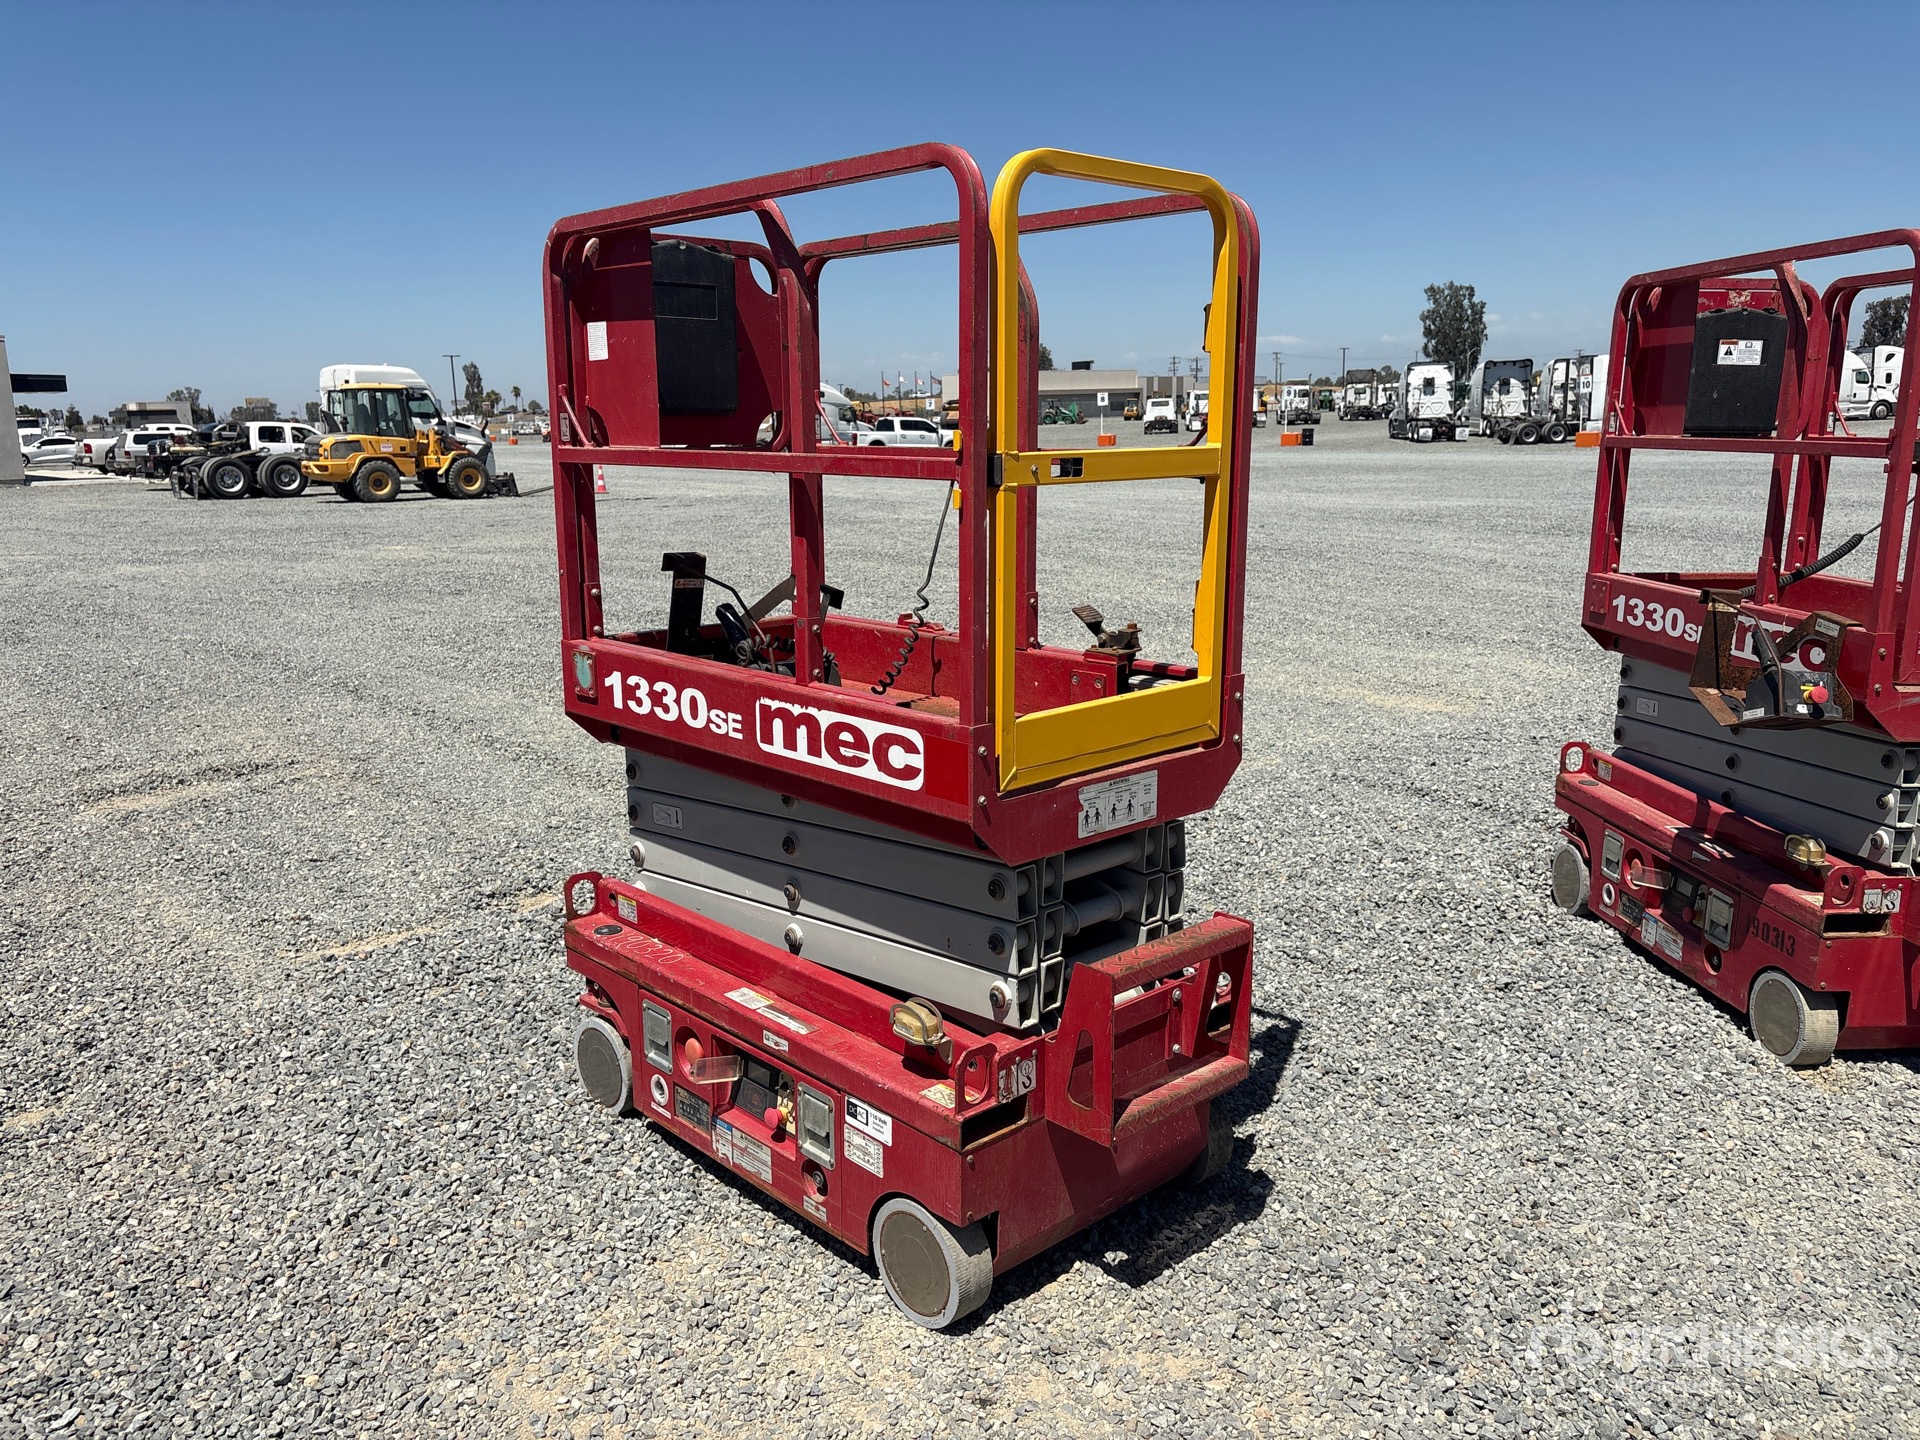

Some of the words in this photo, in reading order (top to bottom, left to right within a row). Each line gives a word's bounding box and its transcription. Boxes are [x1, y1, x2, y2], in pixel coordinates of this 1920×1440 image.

[1582, 381, 1590, 389] 10
[1612, 594, 1703, 644] 1330S
[758, 701, 922, 782] mec
